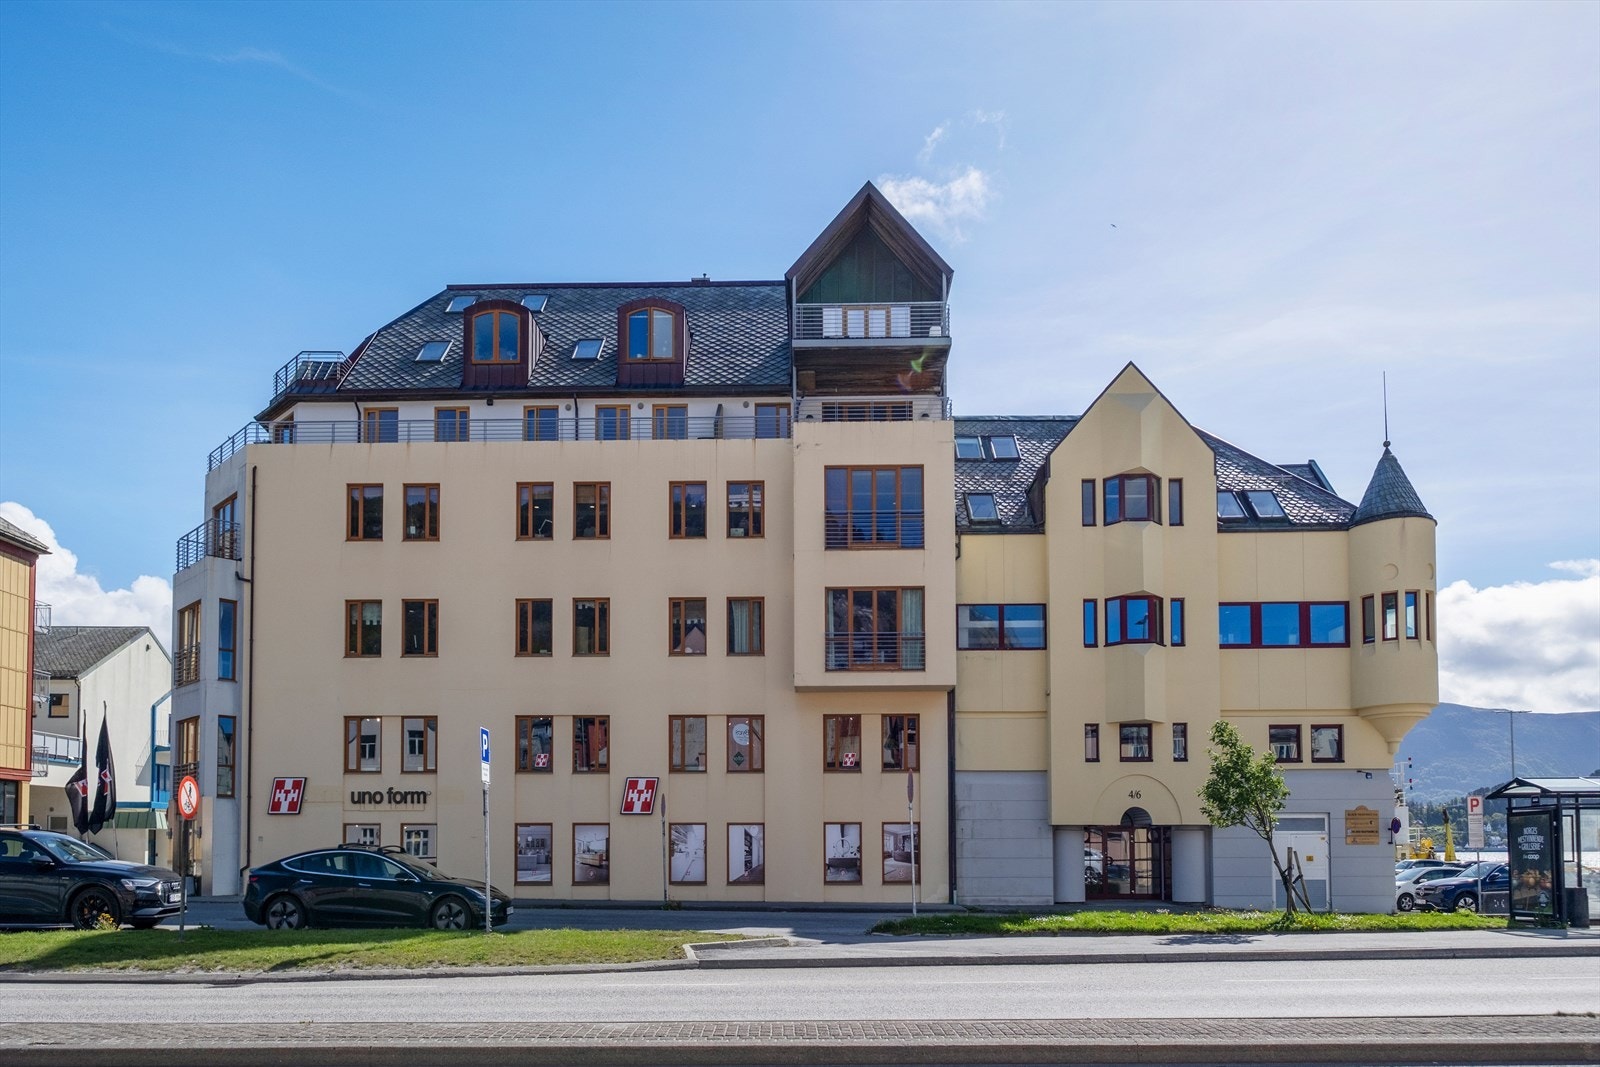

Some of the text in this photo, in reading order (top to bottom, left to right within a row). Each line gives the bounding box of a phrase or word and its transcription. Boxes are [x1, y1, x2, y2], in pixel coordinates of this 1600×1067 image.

[482, 733, 488, 758] P
[350, 791, 384, 804] uno
[1128, 790, 1142, 799] 4/6
[1470, 798, 1480, 813] P
